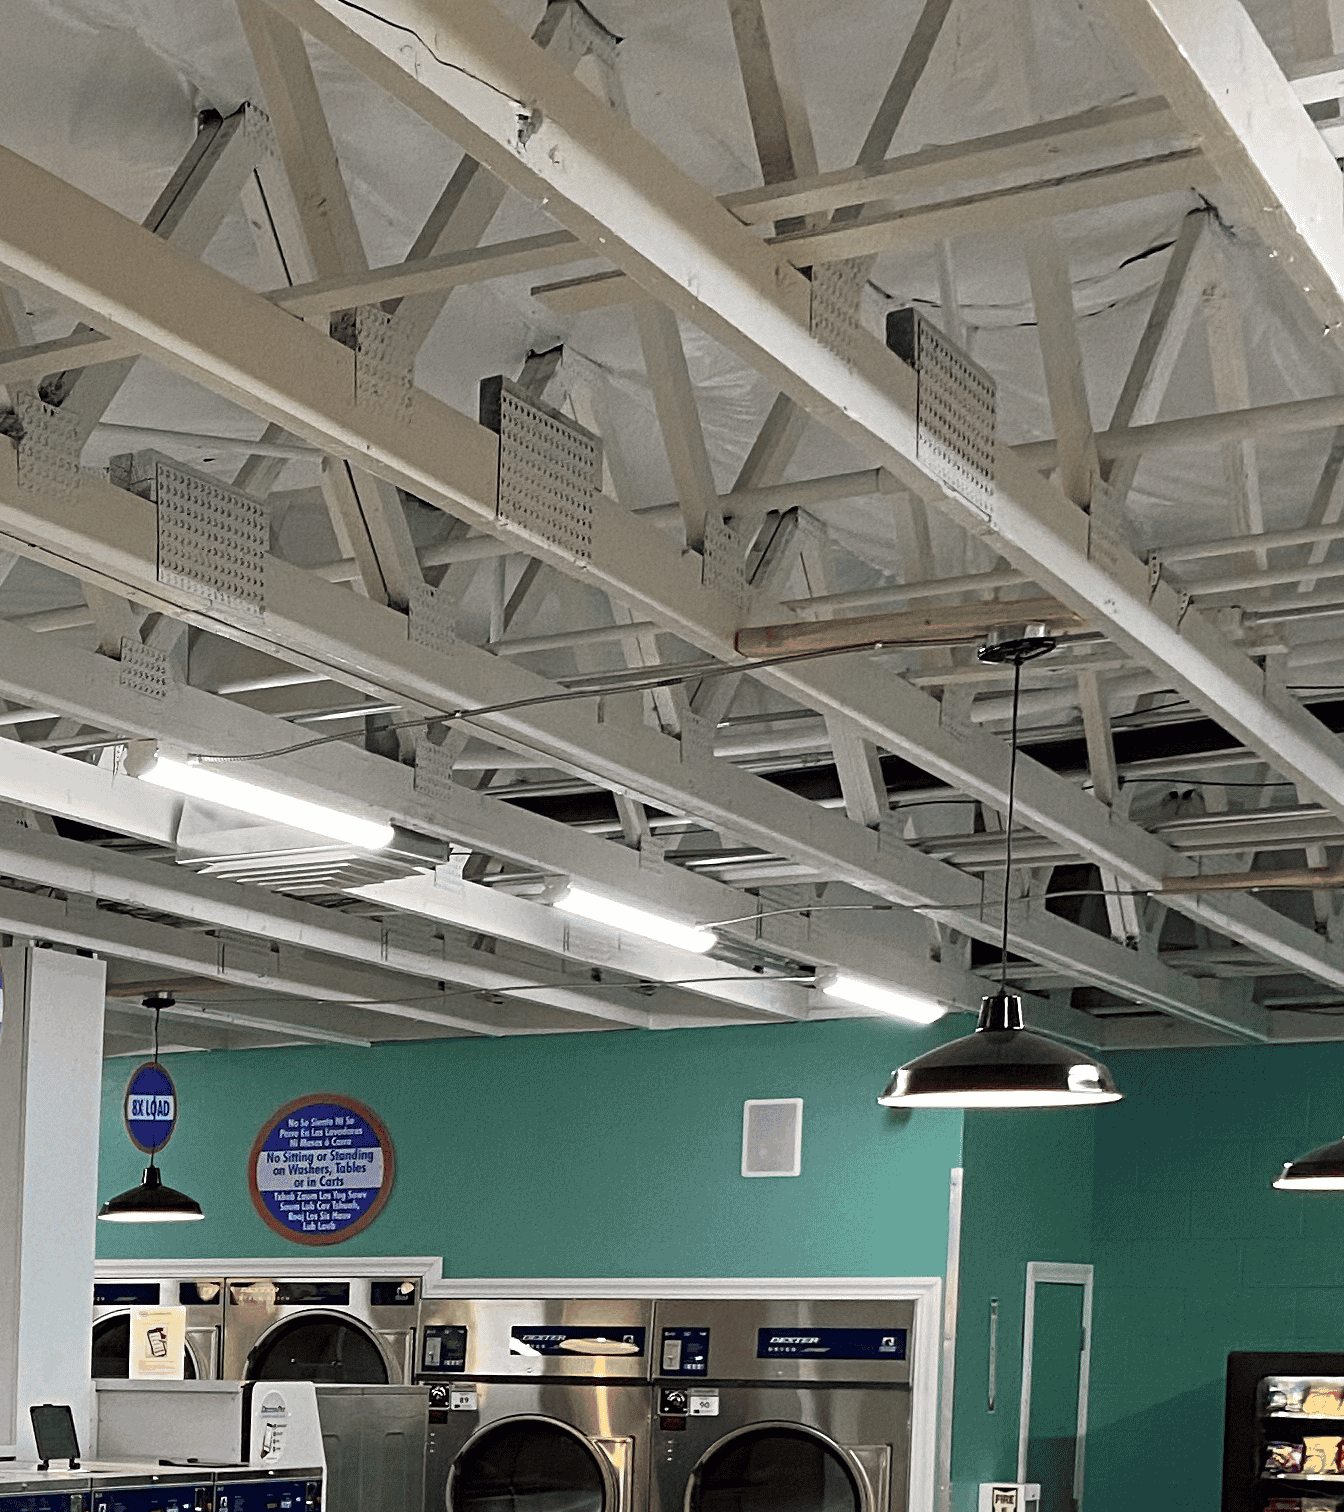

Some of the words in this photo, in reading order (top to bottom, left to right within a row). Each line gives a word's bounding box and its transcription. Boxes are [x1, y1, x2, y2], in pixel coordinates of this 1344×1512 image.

[146, 1099, 170, 1117] LOAD
[266, 1152, 280, 1163] No
[283, 1150, 314, 1164] Sitting
[317, 1153, 327, 1161] or
[330, 1148, 374, 1163] Standing
[273, 1166, 285, 1175] on
[288, 1163, 332, 1175] Washers,
[336, 1161, 366, 1173] Tables
[294, 1179, 304, 1187] or
[306, 1177, 316, 1187] in
[319, 1176, 344, 1187] Carts
[769, 1336, 820, 1344] DEXTER
[995, 1494, 1014, 1504] FIRE
